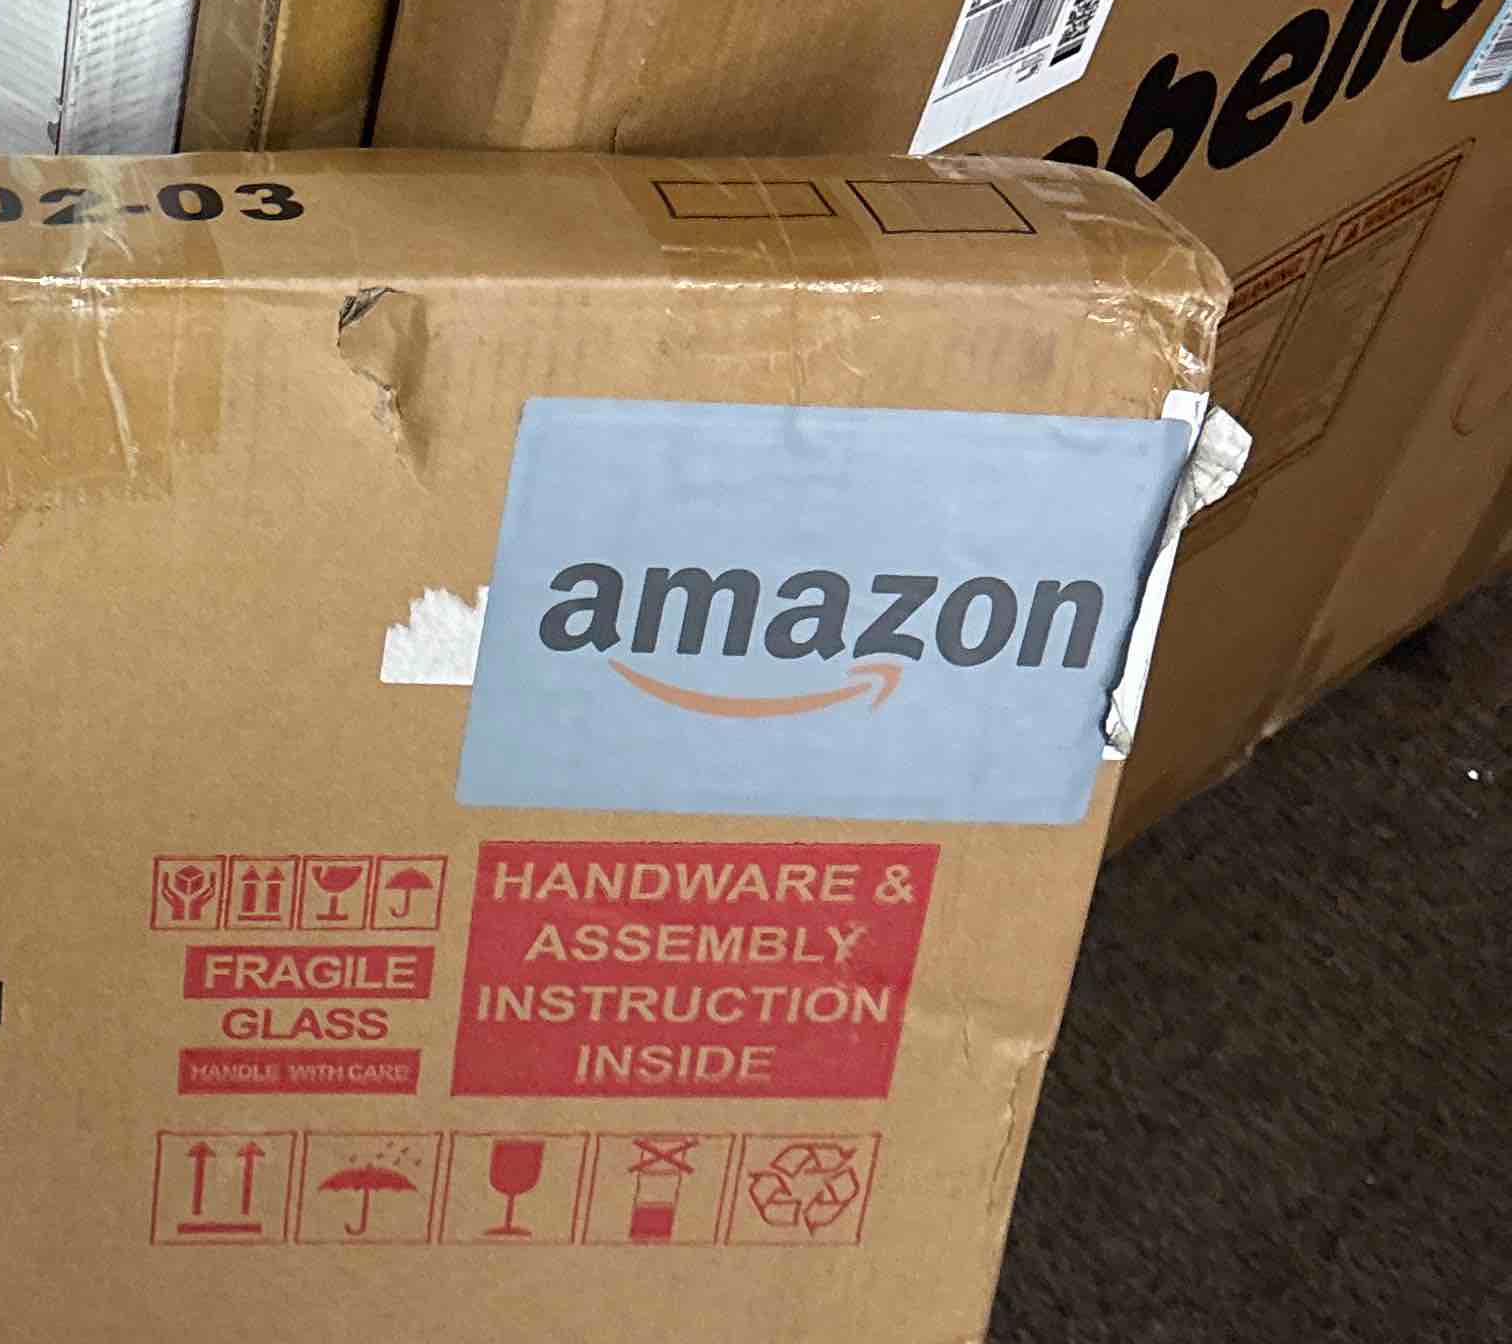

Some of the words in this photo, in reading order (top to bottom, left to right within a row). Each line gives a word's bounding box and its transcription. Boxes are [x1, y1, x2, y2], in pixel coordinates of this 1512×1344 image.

[538, 561, 1105, 670] amazon
[492, 860, 861, 903] HANDWARE
[874, 864, 916, 905] &
[523, 922, 870, 964] ASSEMBLY
[203, 954, 419, 991] FRAGILE
[220, 1006, 390, 1042] GLASS
[475, 983, 893, 1024] INSTRUCTION
[190, 1062, 279, 1083] HANDLE
[288, 1063, 344, 1082] WITH
[347, 1062, 411, 1082] CARE
[574, 1044, 777, 1085] INSIDE
